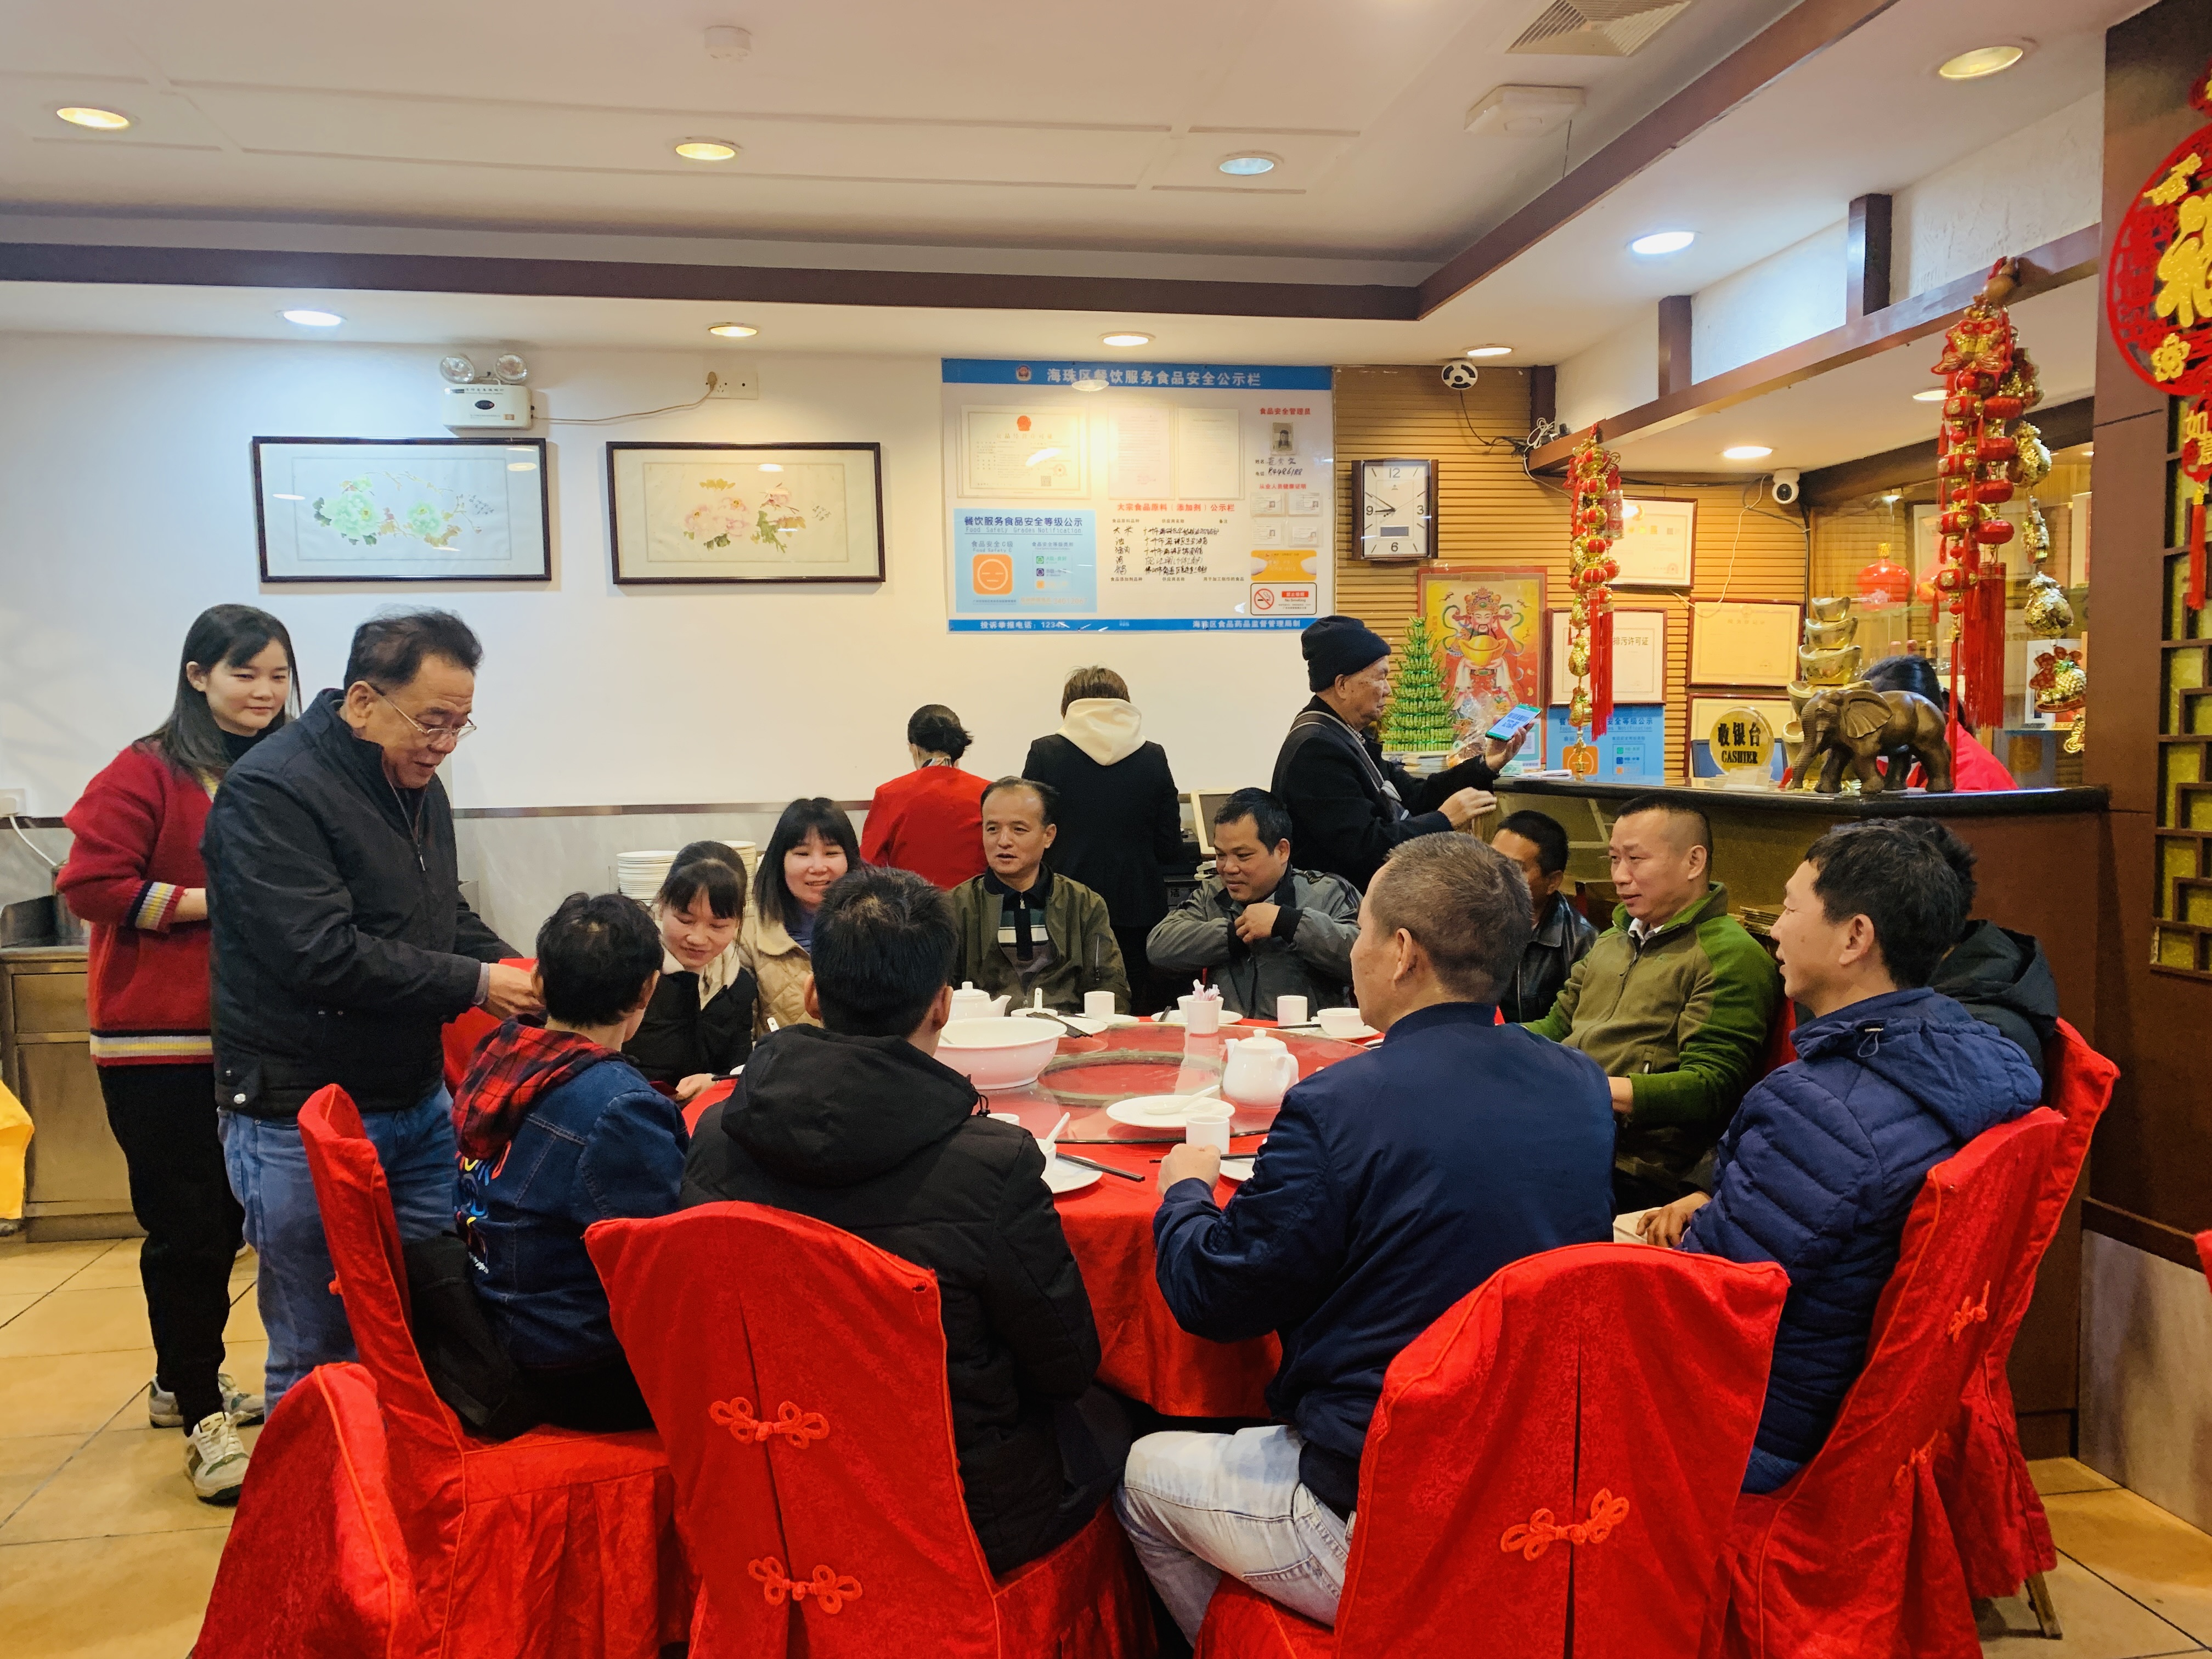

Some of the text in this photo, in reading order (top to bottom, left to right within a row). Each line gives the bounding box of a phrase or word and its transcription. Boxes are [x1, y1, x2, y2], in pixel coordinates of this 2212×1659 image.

[1047, 368, 1261, 386] 海珠区餐饮服务食品安全公示栏
[1389, 468, 1401, 478] 12
[1366, 506, 1373, 516] 9
[1417, 505, 1424, 515] 3
[964, 516, 1083, 527] 餐饮服务食品安全等级公示
[1391, 542, 1398, 552] 6
[1718, 721, 1761, 747] 收银台
[1722, 750, 1758, 764] CASHIER
